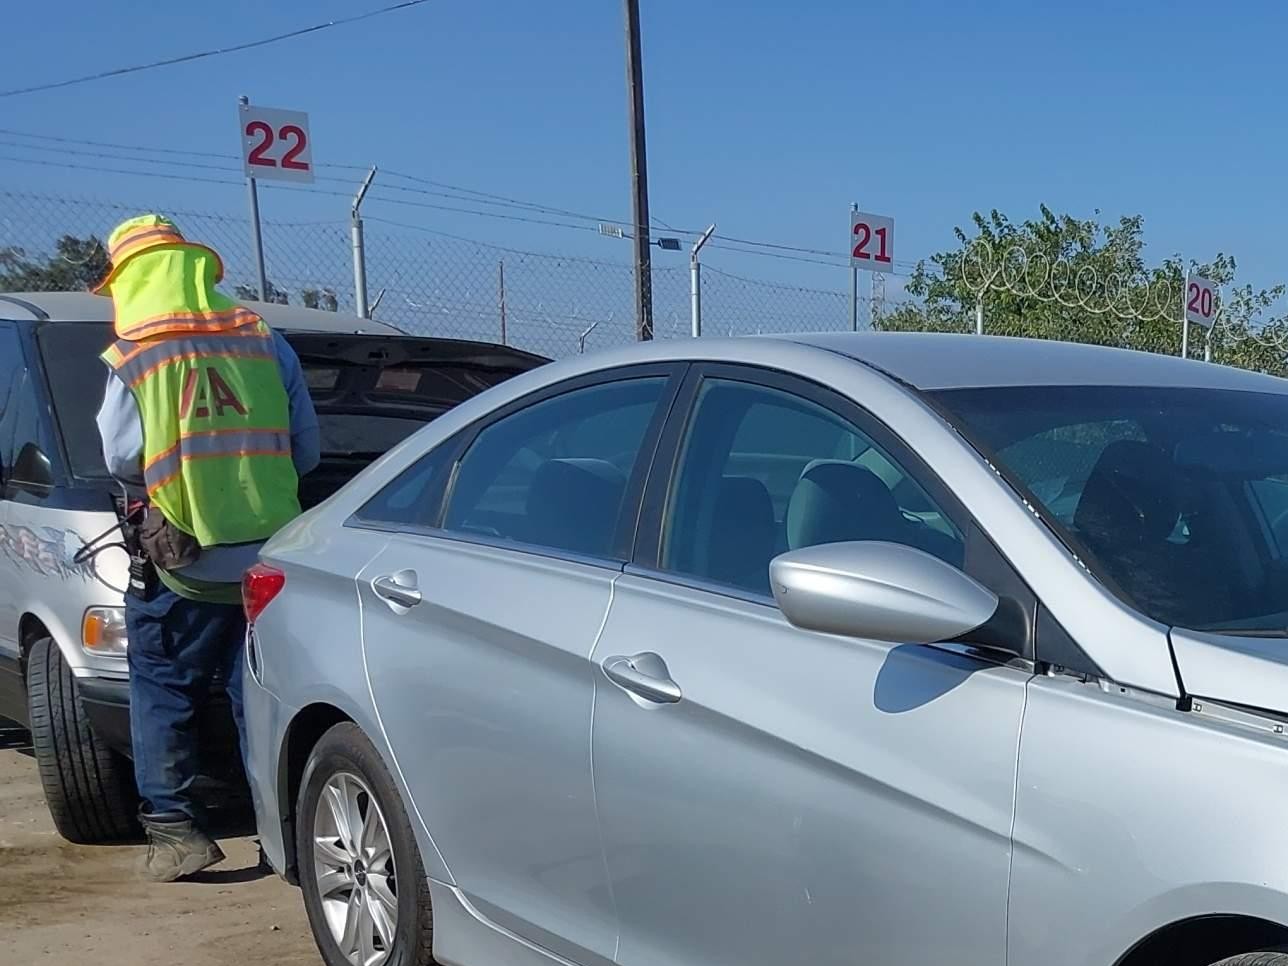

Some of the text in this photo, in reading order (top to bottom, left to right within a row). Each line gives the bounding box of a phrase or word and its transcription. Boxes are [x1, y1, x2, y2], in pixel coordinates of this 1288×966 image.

[246, 121, 309, 170] 22
[853, 223, 891, 263] 21
[1187, 282, 1212, 318] 20
